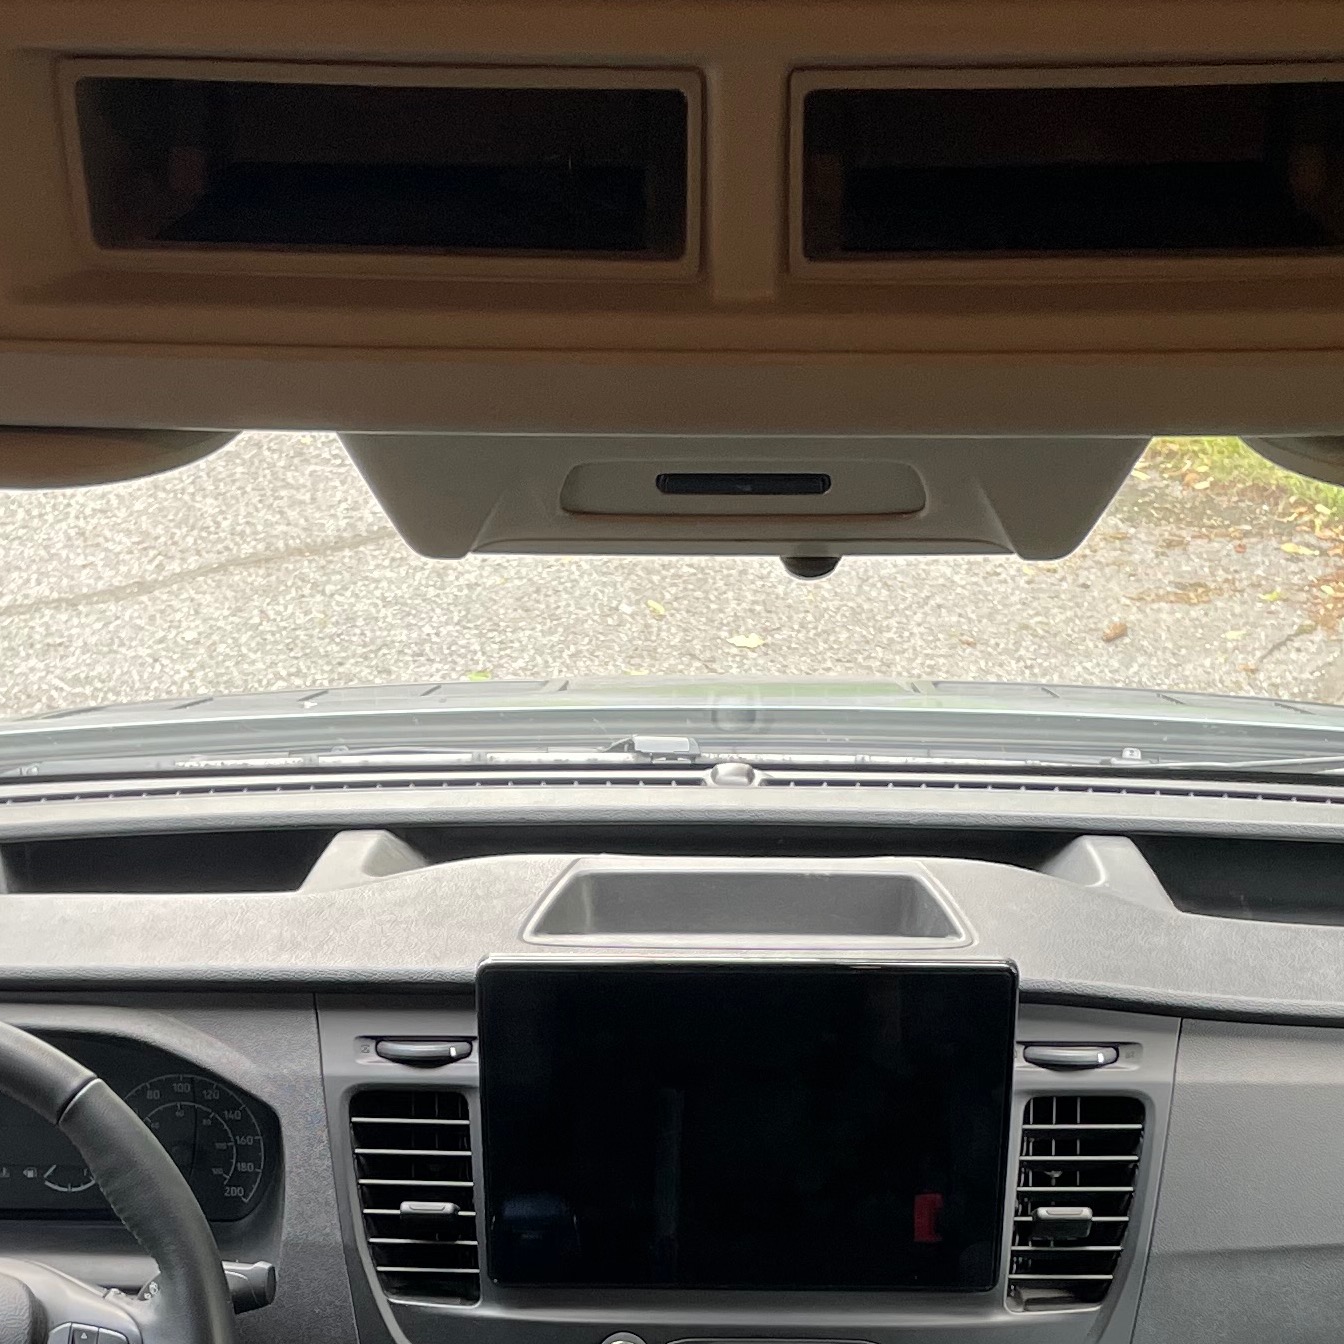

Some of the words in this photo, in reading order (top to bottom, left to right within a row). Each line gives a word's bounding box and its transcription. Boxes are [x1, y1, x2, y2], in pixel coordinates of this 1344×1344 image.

[173, 1083, 191, 1092] 100
[146, 1090, 160, 1099] 80
[202, 1090, 220, 1099] 120
[223, 1110, 242, 1120] 140
[235, 1136, 253, 1145] 160
[236, 1162, 254, 1172] 180
[224, 1187, 244, 1196] 200
